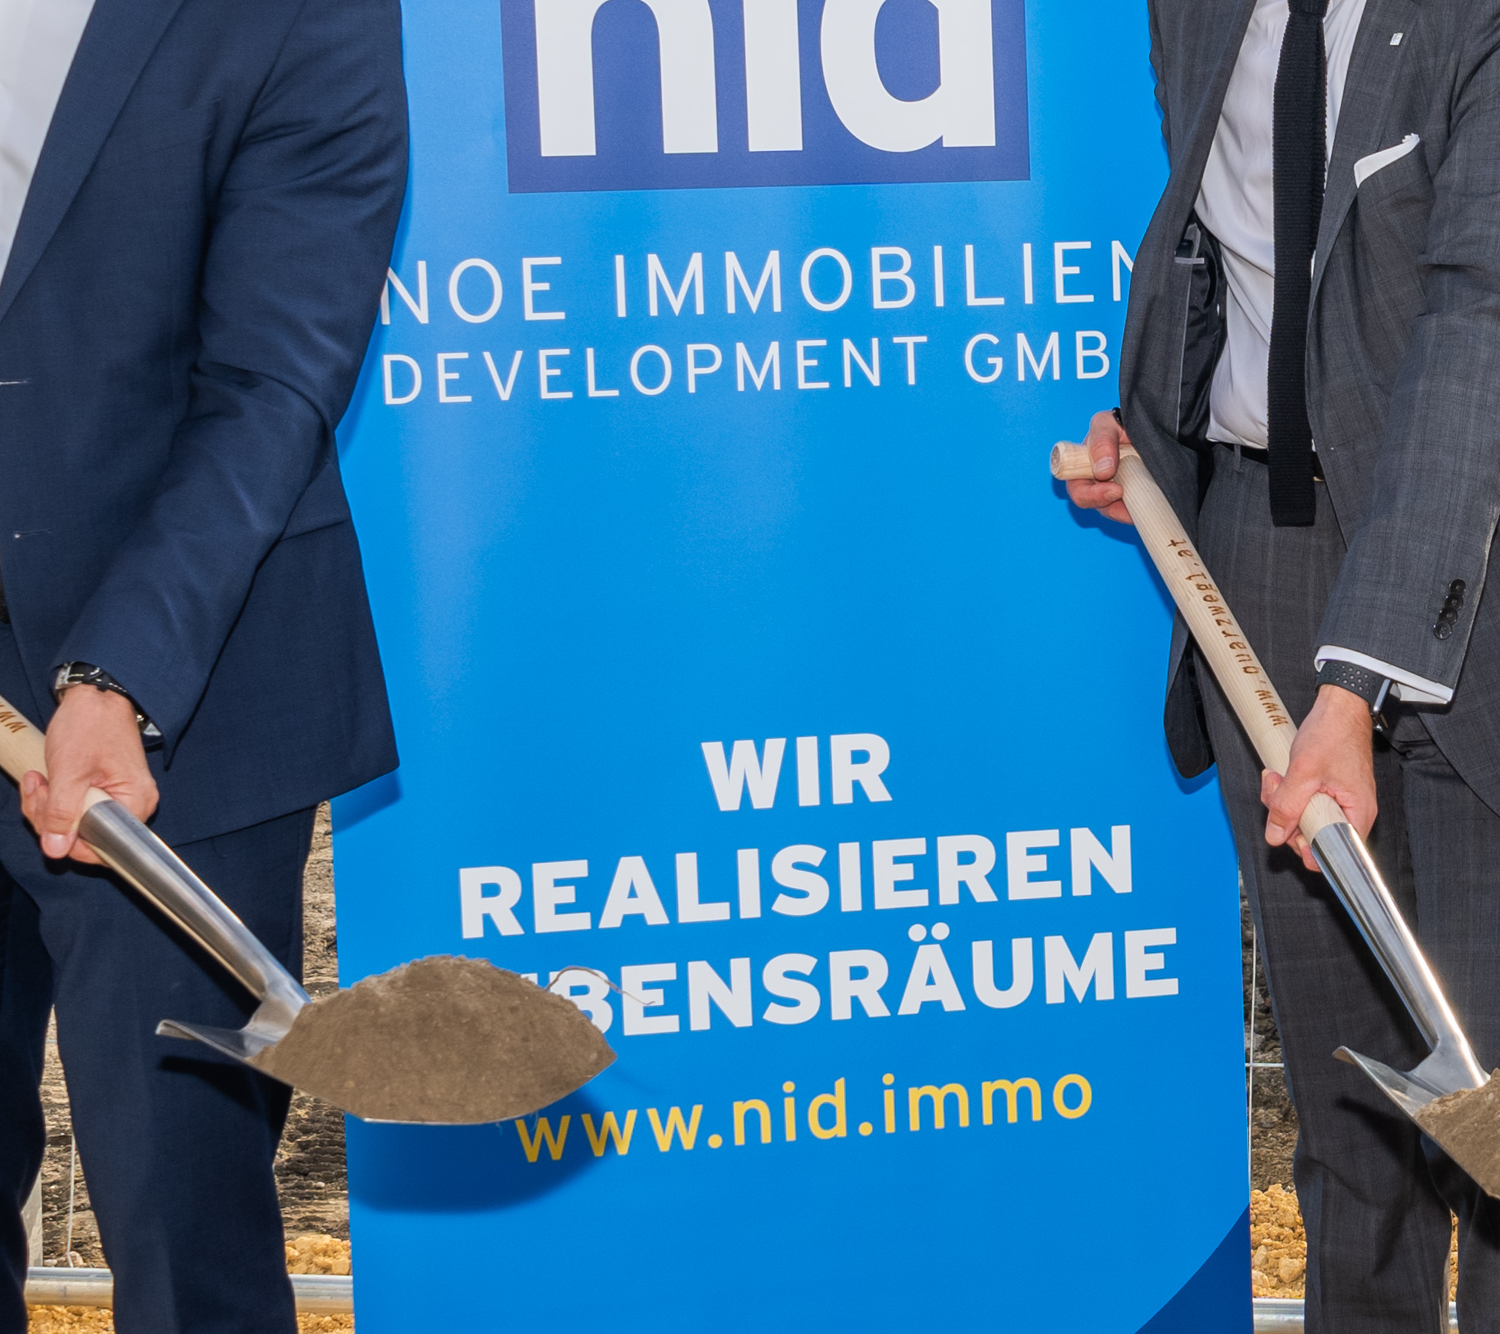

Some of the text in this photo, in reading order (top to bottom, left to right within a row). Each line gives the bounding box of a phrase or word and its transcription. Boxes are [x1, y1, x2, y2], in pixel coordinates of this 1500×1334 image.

[380, 239, 1134, 325] NOE IMMOBILIEN
[383, 335, 929, 405] DEVELOPMENT
[1167, 537, 1288, 727] www.quarzwegl.at
[700, 732, 893, 812] WIR
[458, 824, 1134, 940] REALISIEREN
[521, 921, 1180, 1037] BENSRÄUME
[518, 1073, 1093, 1164] www.nid.immo
